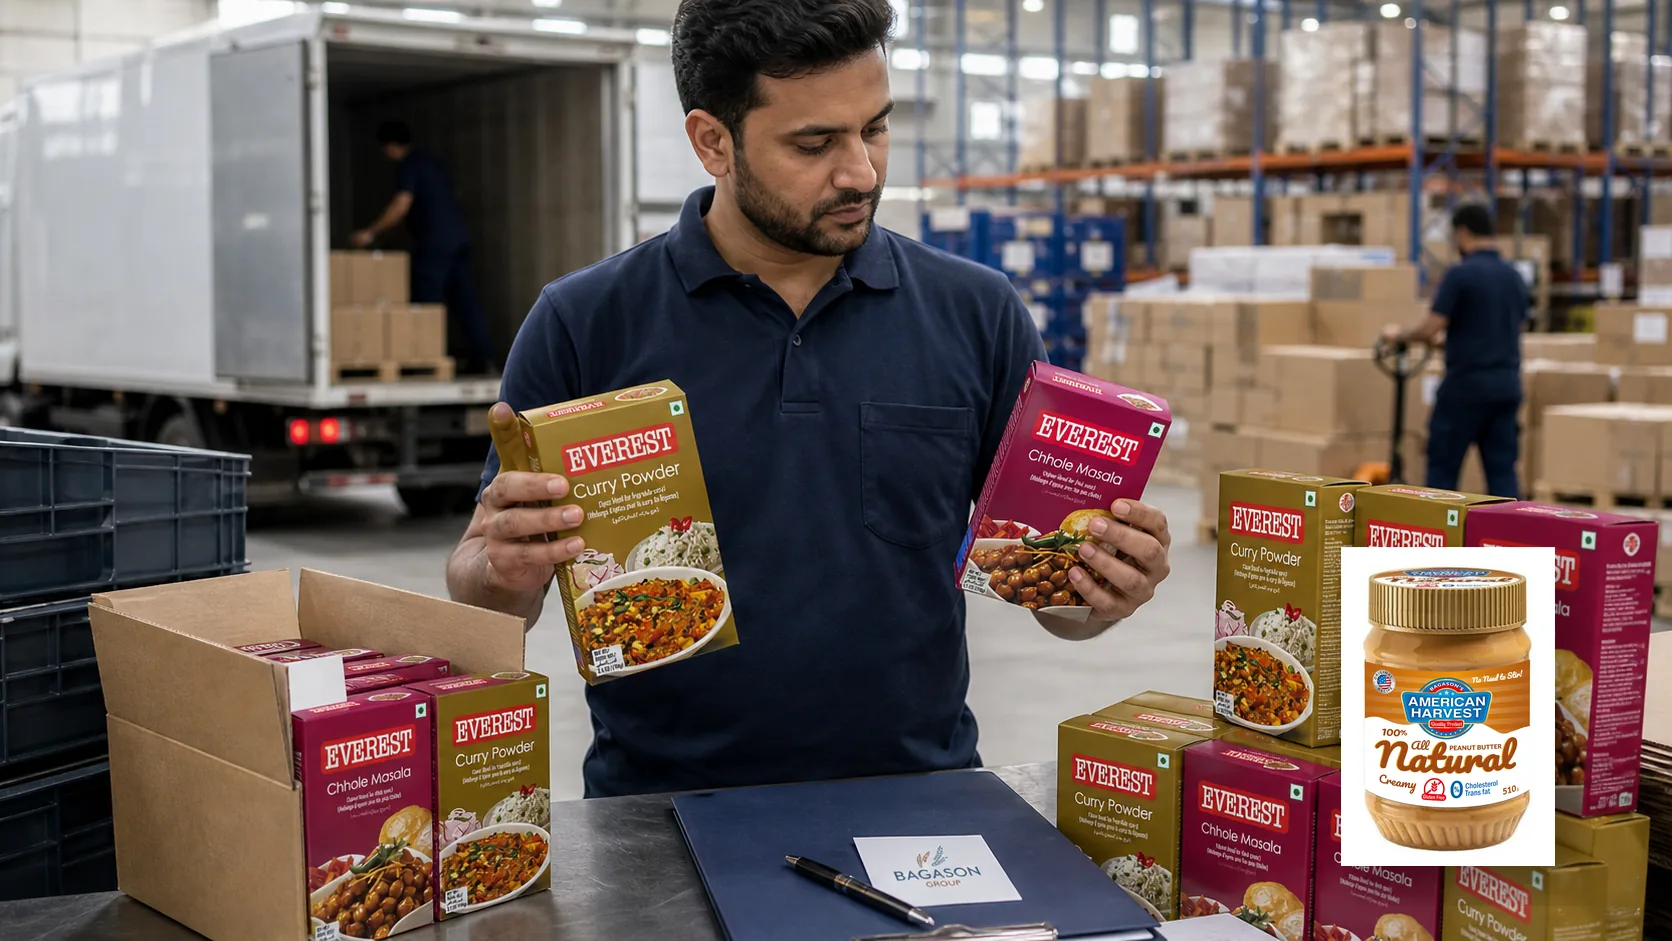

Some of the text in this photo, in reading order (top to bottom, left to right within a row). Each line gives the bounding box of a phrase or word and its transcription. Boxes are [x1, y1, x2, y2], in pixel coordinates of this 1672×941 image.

[566, 427, 672, 473] EVEREST
[1036, 413, 1139, 462] EVEREST
[573, 462, 681, 500] Curry Powder
[1028, 449, 1074, 472] Chhole
[1076, 463, 1123, 486] Masala
[1231, 505, 1302, 540] EVEREST
[1230, 542, 1302, 567] Curry Powder
[1429, 681, 1464, 692] BAGASON'S
[1471, 669, 1524, 684] No Need to Stir!
[1408, 696, 1486, 707] AMERICAN
[1411, 708, 1482, 718] HARVEST
[455, 707, 534, 743] EVEREST
[1381, 728, 1408, 737] 100%
[325, 729, 412, 770] EVEREST
[455, 741, 535, 767] Curry Powder
[1374, 736, 1518, 775] Natural
[1411, 740, 1431, 751] All
[1476, 743, 1503, 751] BUTTER
[327, 766, 411, 796] Chhole Masala
[1075, 757, 1153, 796] EVEREST
[1379, 774, 1417, 794] Creamy
[1465, 780, 1499, 789] Cholesterol
[1074, 791, 1153, 821] Curry Powder
[1465, 789, 1481, 797] Trans
[1201, 785, 1285, 829] EVEREST
[1201, 821, 1282, 855] Chhole Masala
[893, 866, 982, 881] BAGASON
[926, 879, 961, 888] GROUP
[1372, 866, 1413, 888] Masala
[1459, 866, 1529, 918] EVEREST
[1457, 898, 1486, 926] Curry
